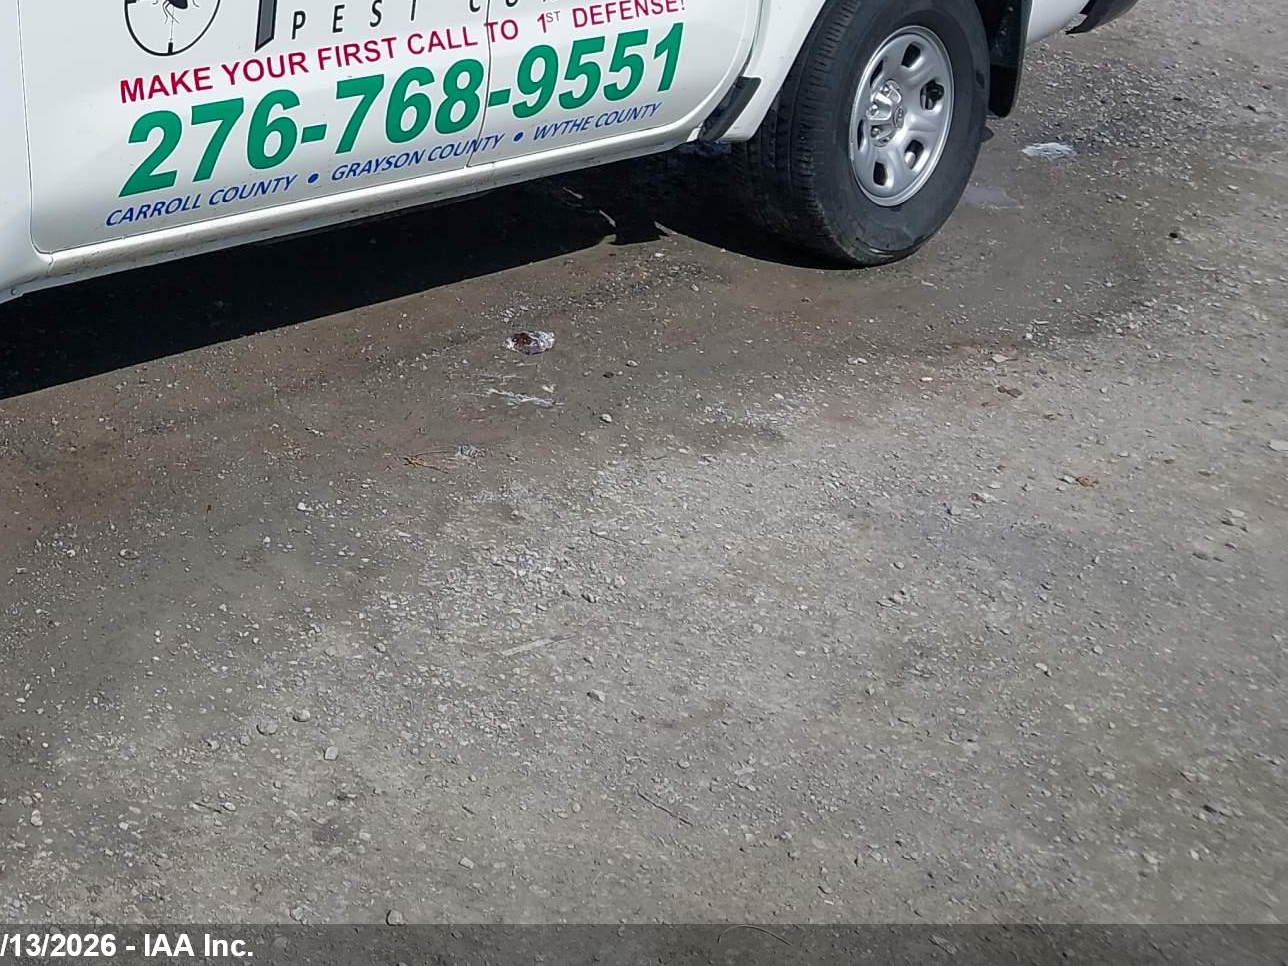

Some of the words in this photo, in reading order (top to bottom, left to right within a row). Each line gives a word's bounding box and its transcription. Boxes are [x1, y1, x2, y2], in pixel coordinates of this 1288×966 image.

[118, 22, 684, 197] 276-768-9551
[120, 66, 213, 103] MAKE
[221, 52, 309, 85] YOUR
[317, 37, 397, 70] FIRST
[407, 26, 478, 55] CALL
[484, 19, 519, 43] TO
[106, 197, 201, 226] CARROLL
[208, 173, 298, 206] COUNTY
[331, 149, 424, 181] GRAYSON
[428, 133, 505, 161] COUNTY
[533, 117, 591, 141] WYTHE
[598, 102, 662, 127] COUNTY
